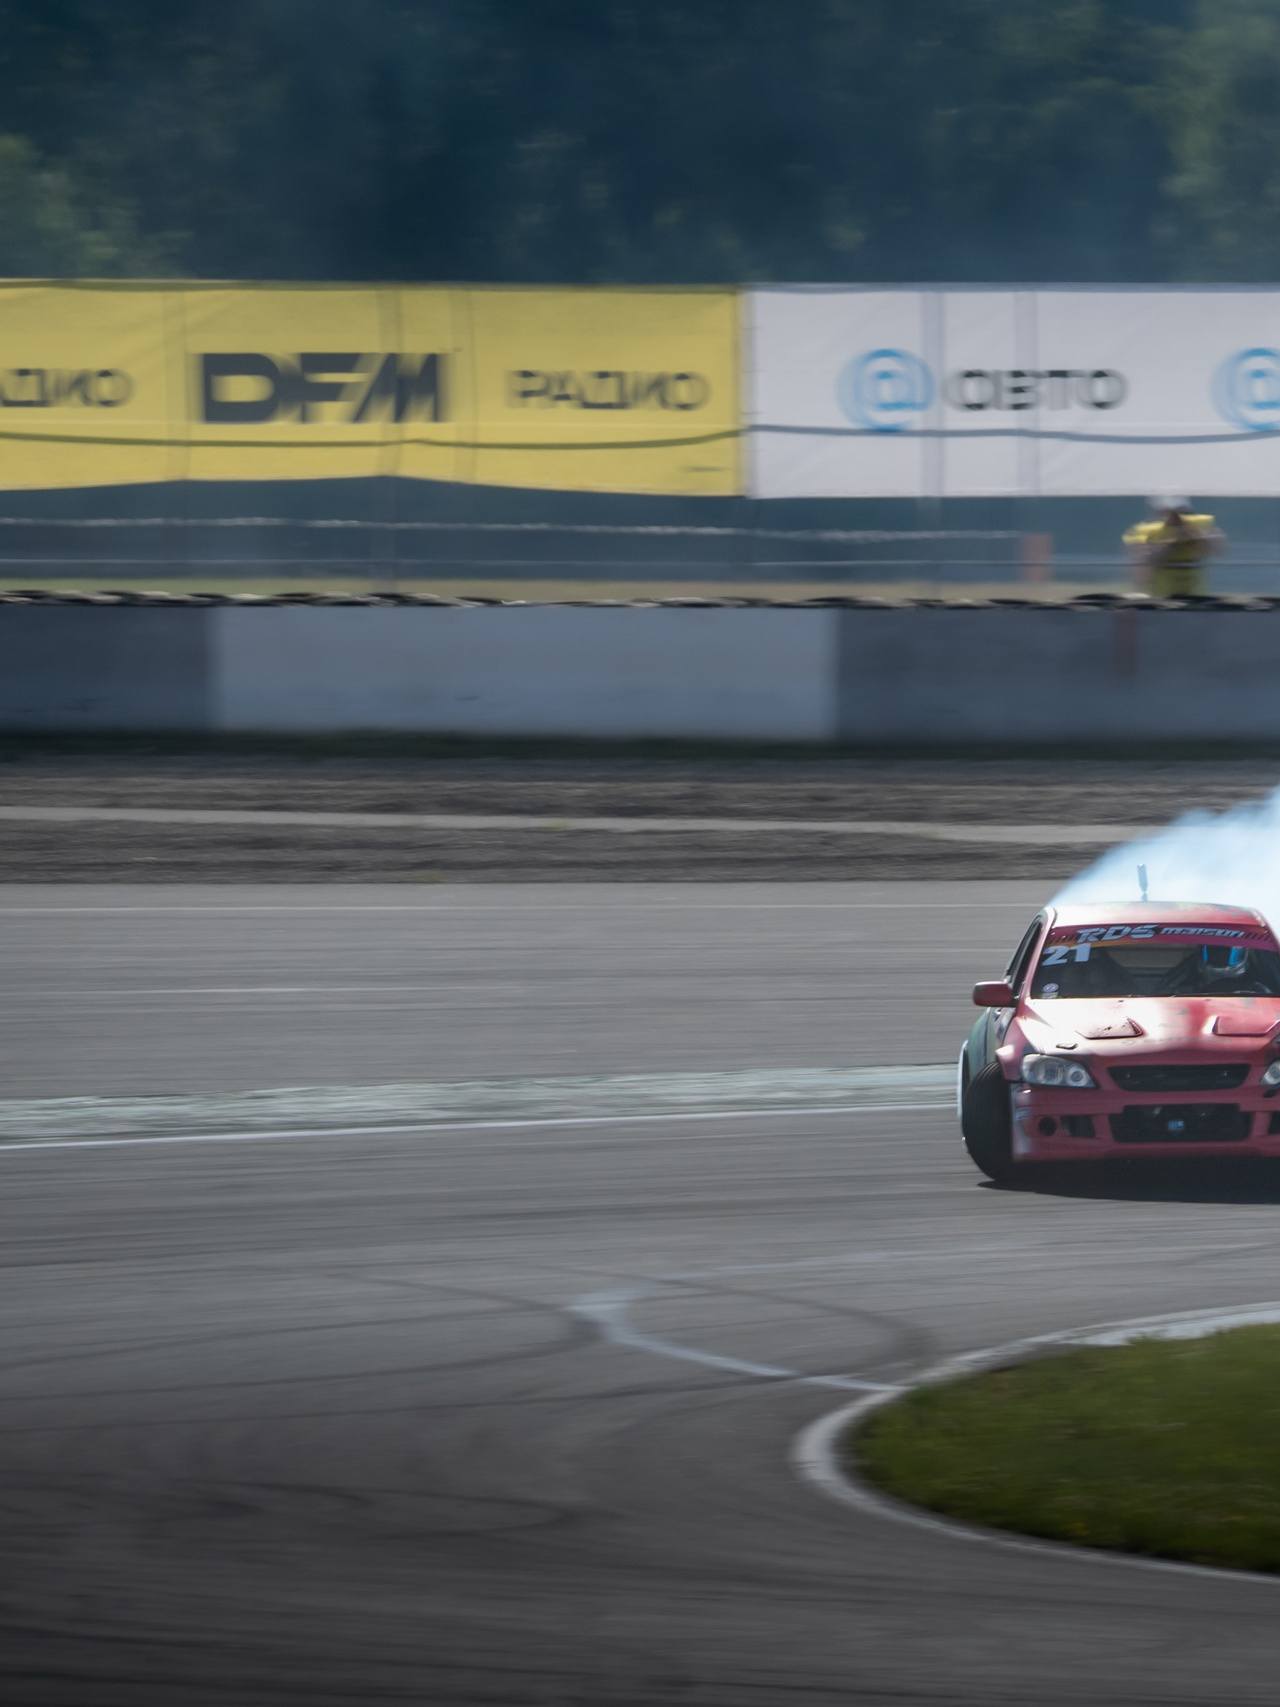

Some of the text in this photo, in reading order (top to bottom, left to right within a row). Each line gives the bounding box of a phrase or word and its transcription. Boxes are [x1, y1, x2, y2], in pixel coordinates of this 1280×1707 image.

[0, 368, 135, 409] ДИО
[197, 351, 450, 423] DFM
[504, 369, 711, 411] РАДИО
[1041, 942, 1091, 966] 21
[1077, 924, 1159, 943] RDS
